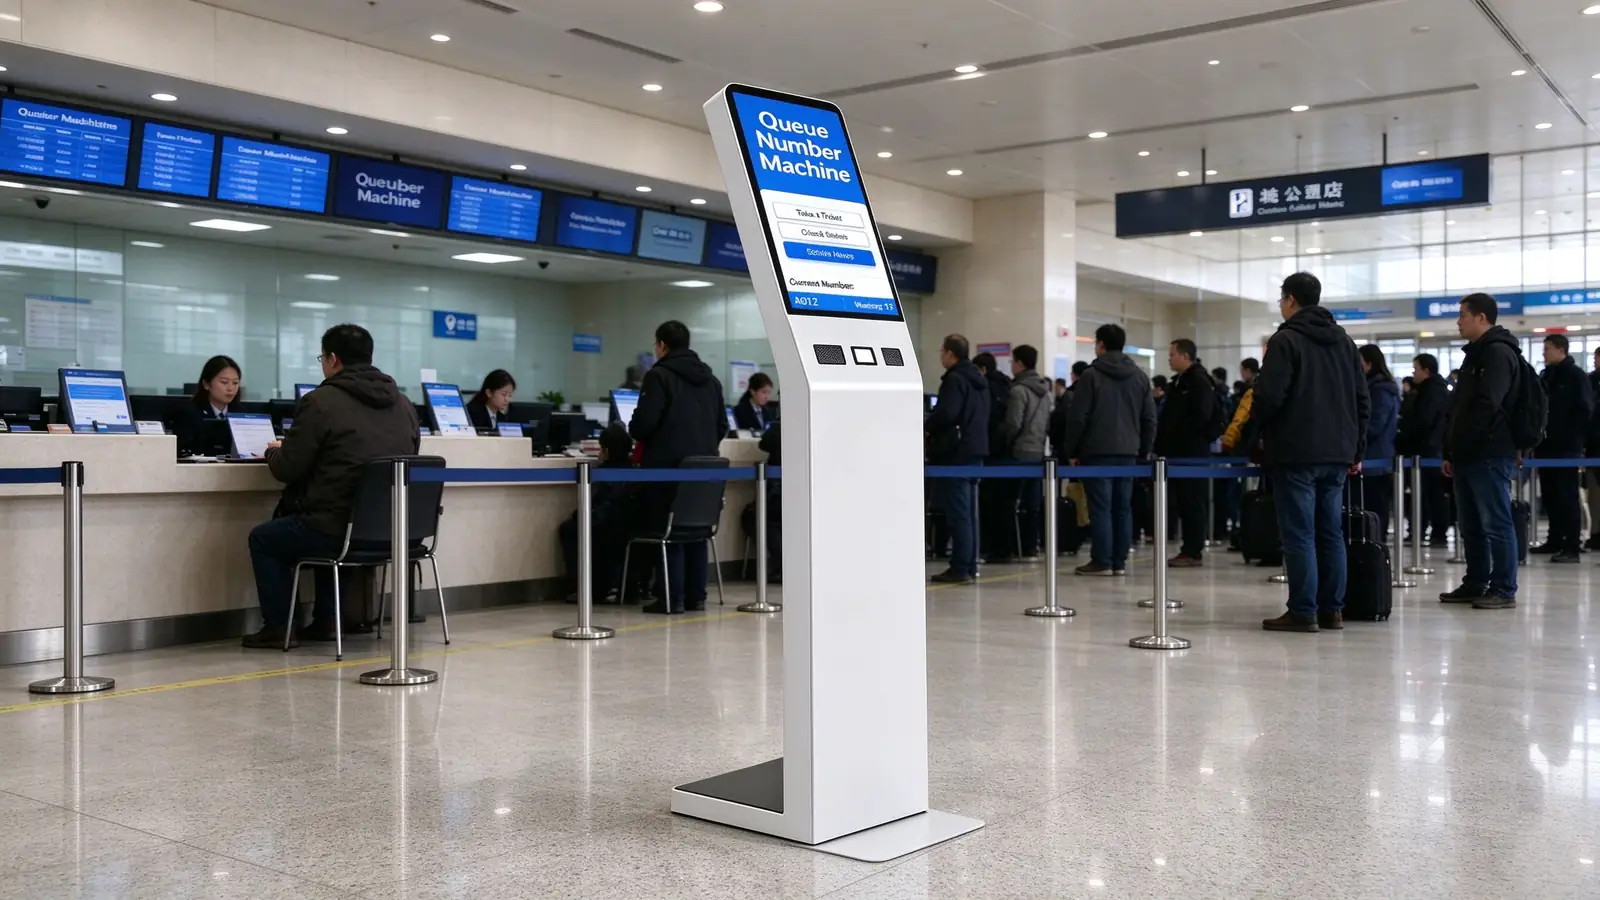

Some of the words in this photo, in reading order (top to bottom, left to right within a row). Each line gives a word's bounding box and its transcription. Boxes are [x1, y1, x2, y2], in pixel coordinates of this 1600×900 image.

[758, 111, 829, 138] Queue
[756, 130, 842, 161] Number
[759, 152, 851, 183] Machine
[355, 172, 424, 195] Queuber
[357, 188, 421, 208] Machine
